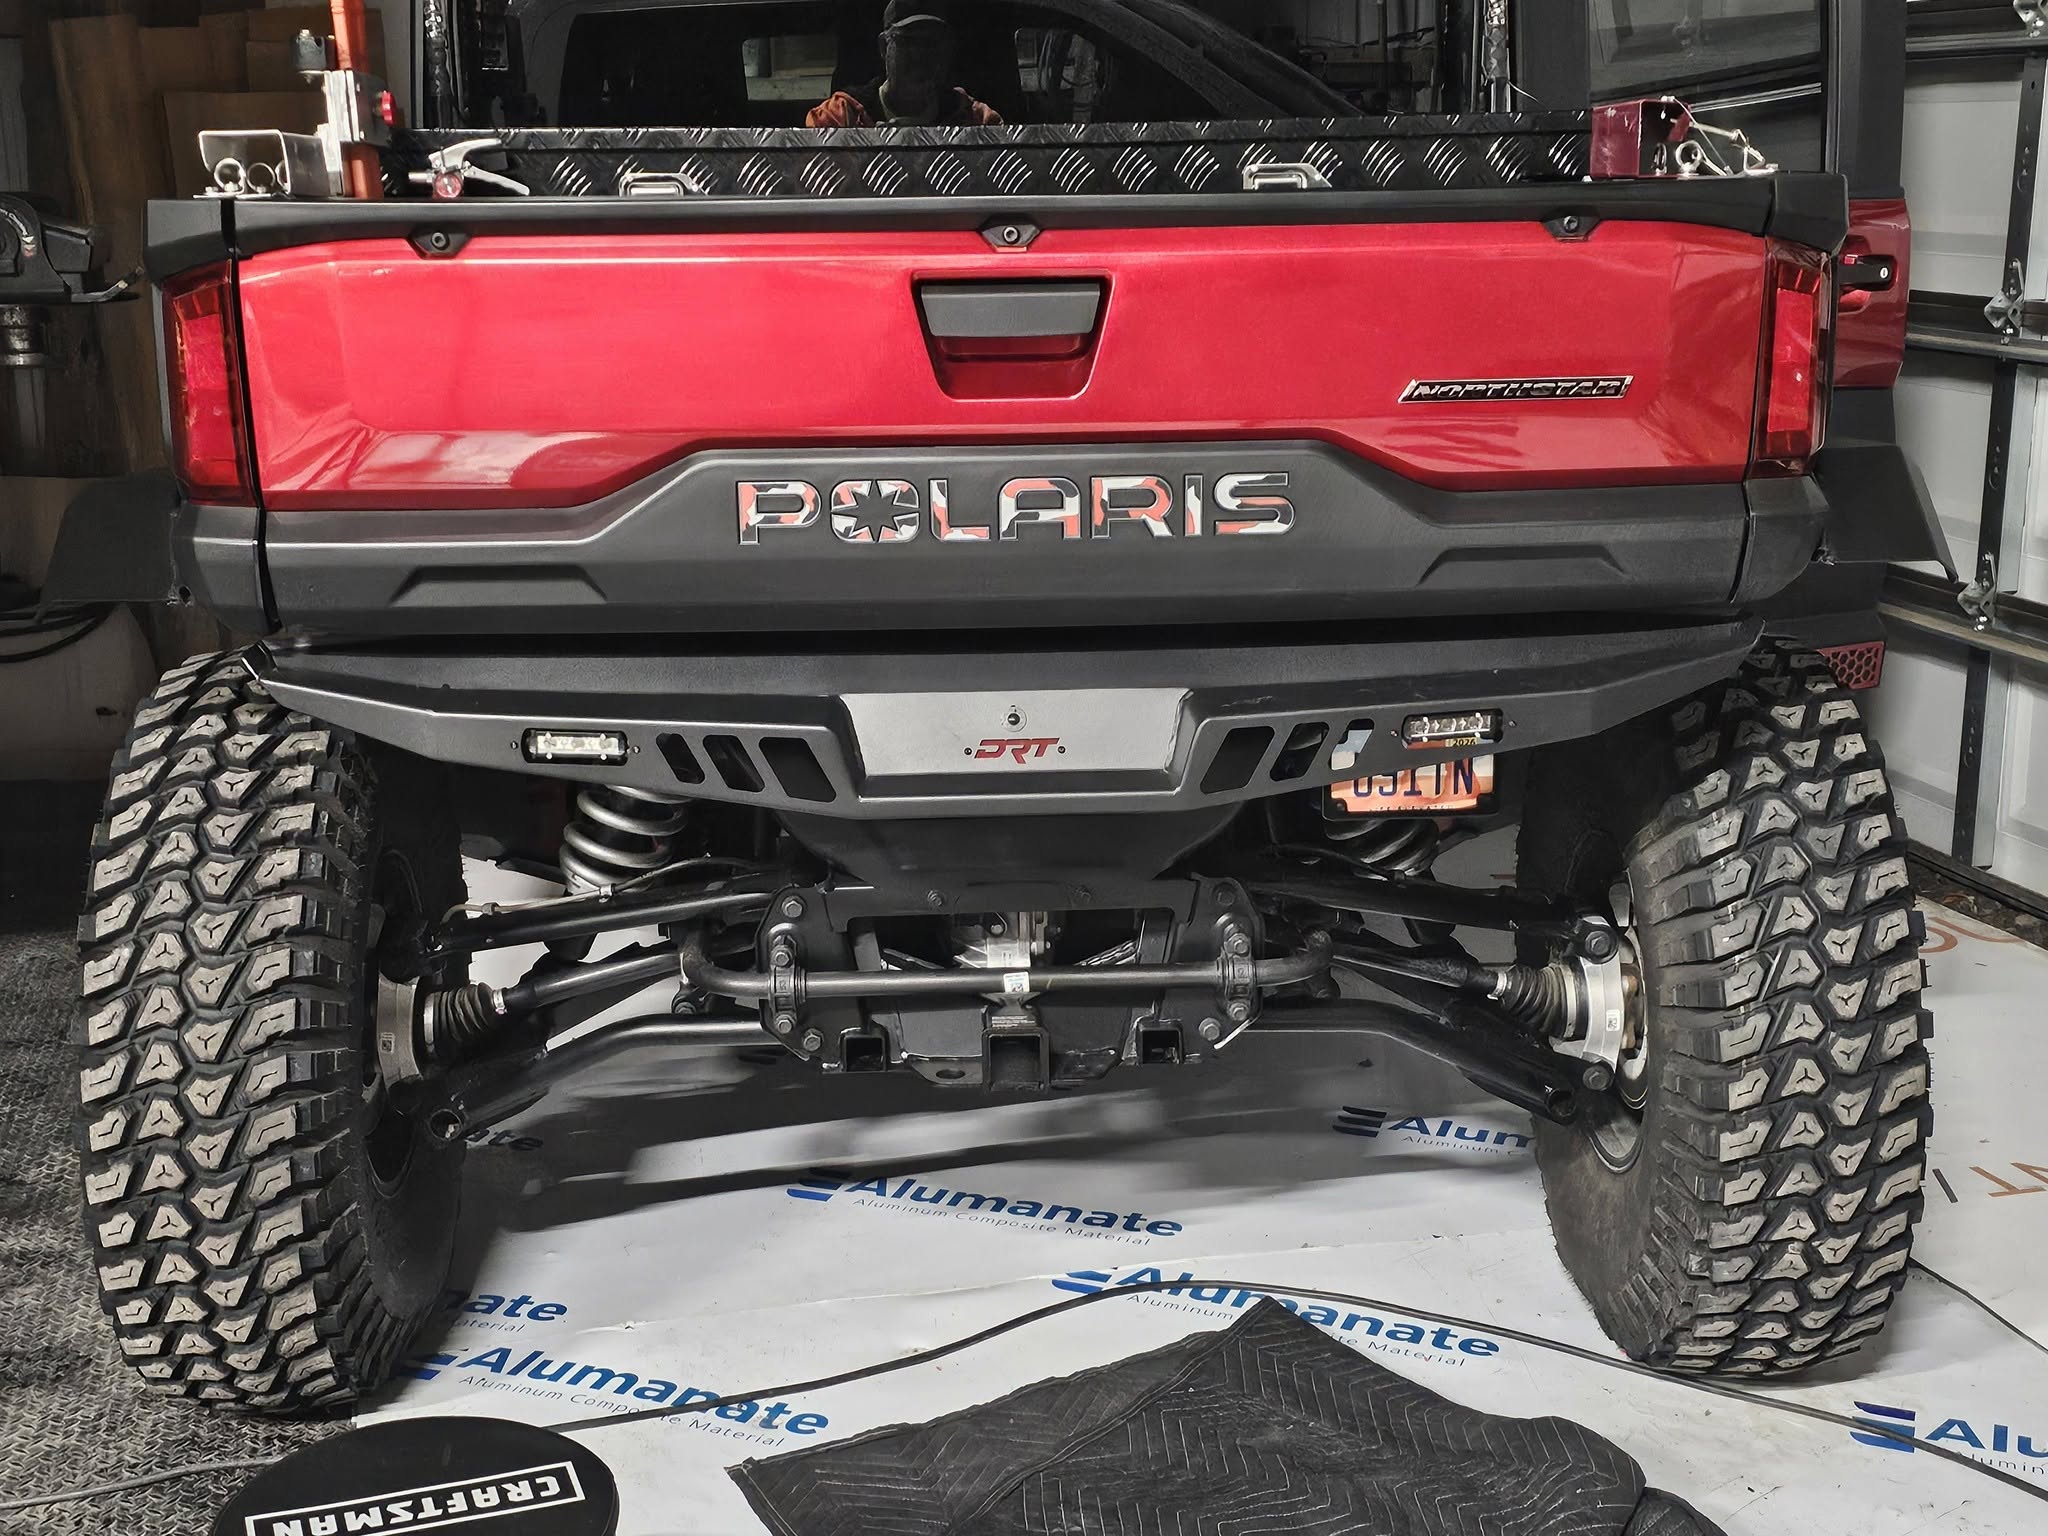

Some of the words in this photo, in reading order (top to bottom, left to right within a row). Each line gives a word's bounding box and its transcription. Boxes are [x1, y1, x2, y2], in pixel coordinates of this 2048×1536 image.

[737, 472, 1296, 545] POLARIS
[973, 738, 1060, 764] DRT
[844, 1176, 1184, 1237] Alumanate
[852, 1198, 949, 1218] Aluminum
[955, 1211, 1058, 1234] Composite
[1064, 1226, 1152, 1247] Material
[452, 1318, 526, 1333] aterial
[1127, 1293, 1234, 1321] Aluminum
[1368, 1340, 1466, 1367] Material
[459, 1374, 563, 1401] Aluminum
[688, 1419, 785, 1448] Material
[271, 1474, 562, 1536] CRAFTSMAN
